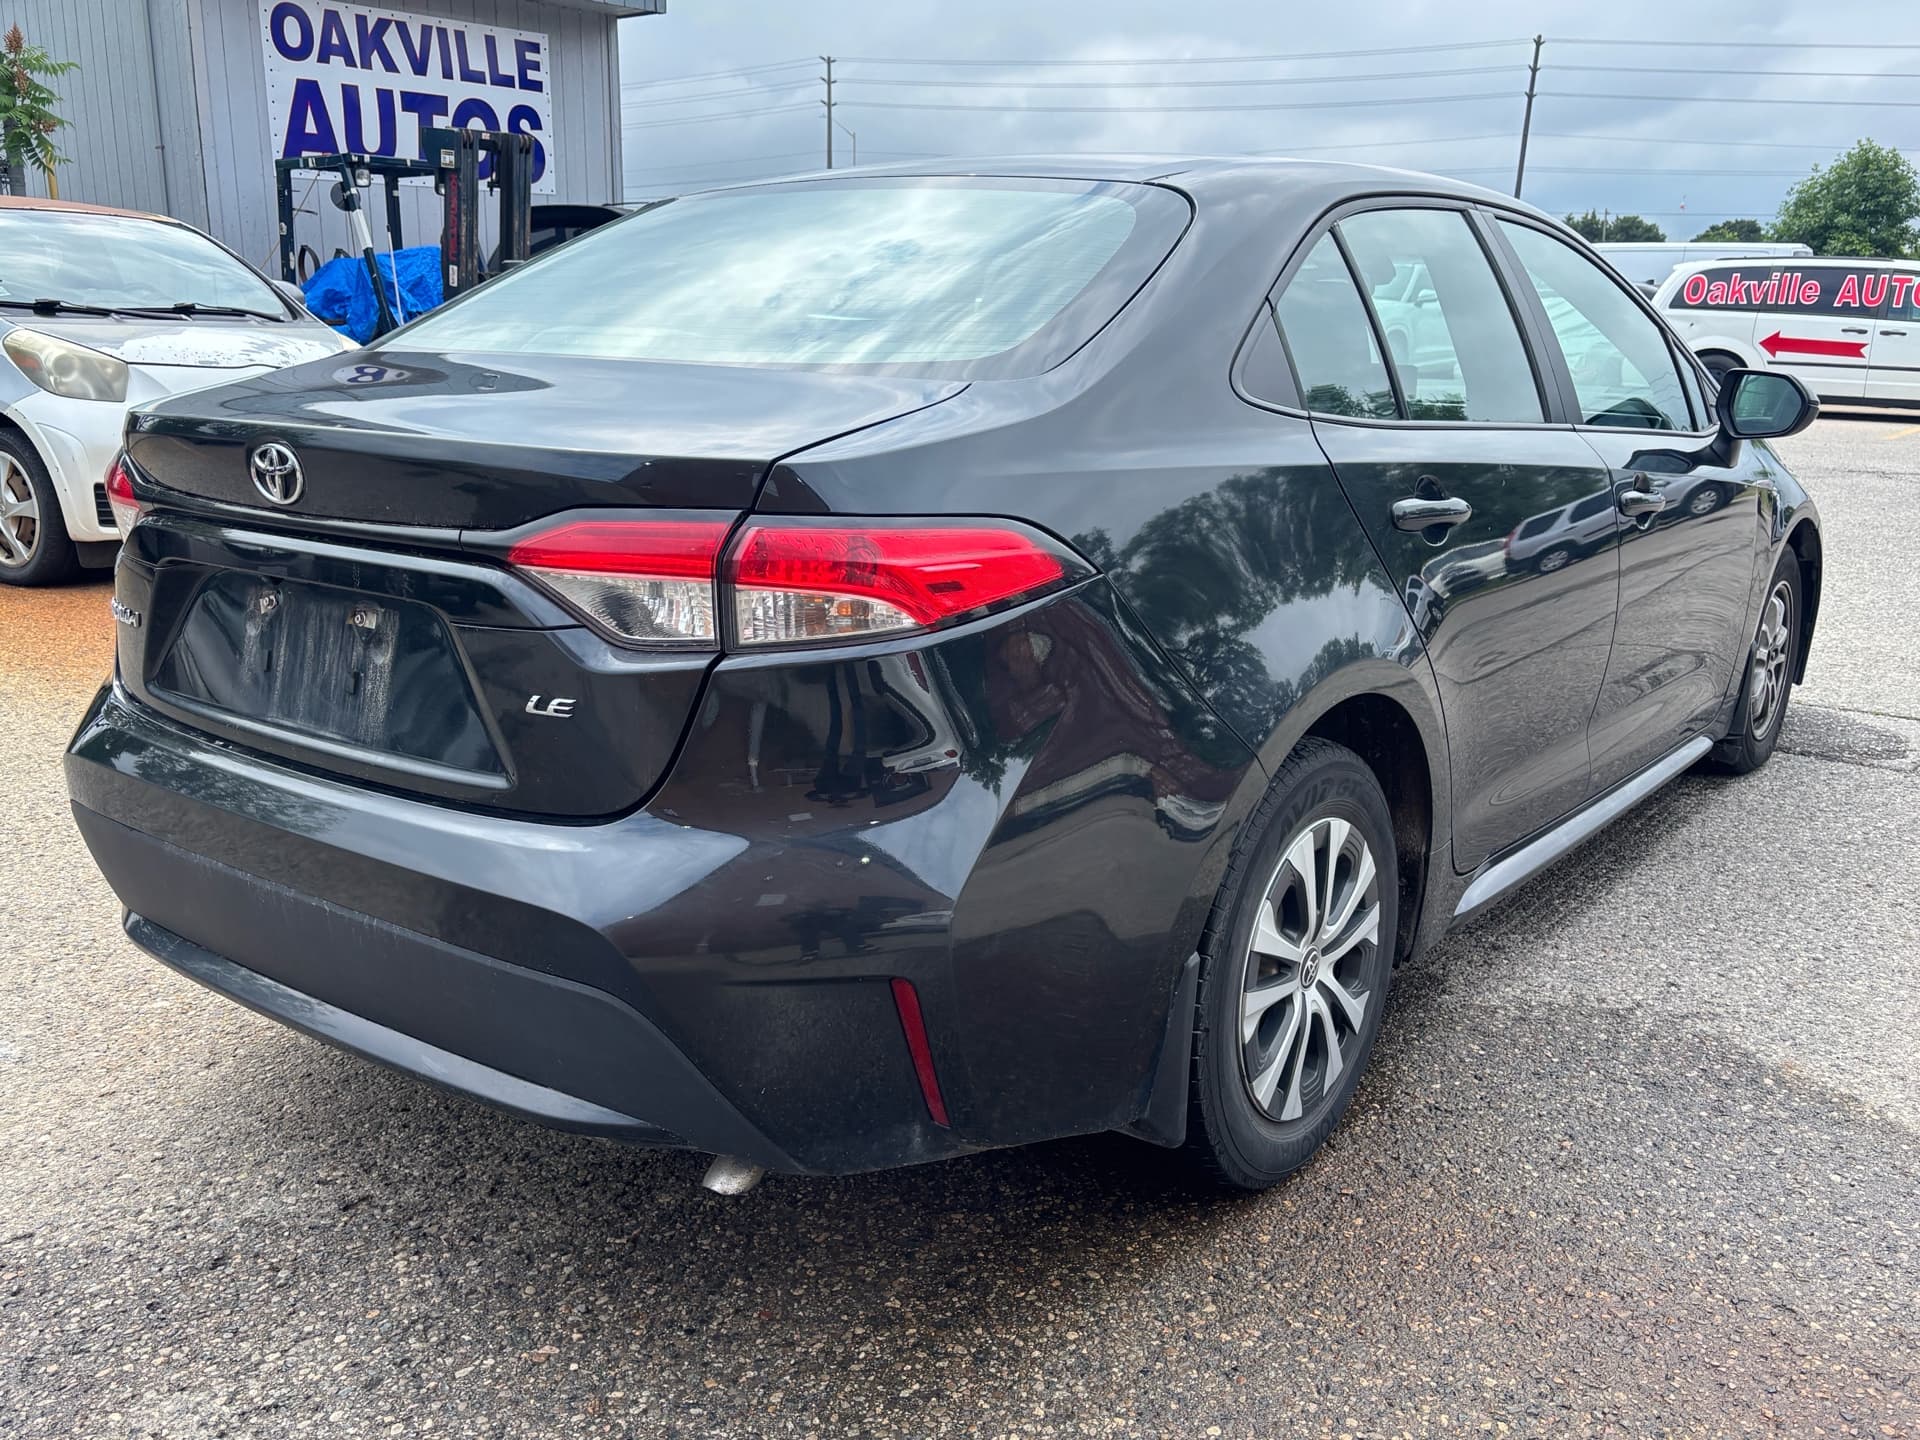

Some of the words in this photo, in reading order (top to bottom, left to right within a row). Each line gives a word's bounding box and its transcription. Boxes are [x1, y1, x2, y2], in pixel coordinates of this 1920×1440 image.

[270, 2, 544, 93] OAKVILLE
[282, 78, 546, 184] AUTOS
[1683, 272, 1821, 306] Oakville
[525, 695, 577, 718] LE
